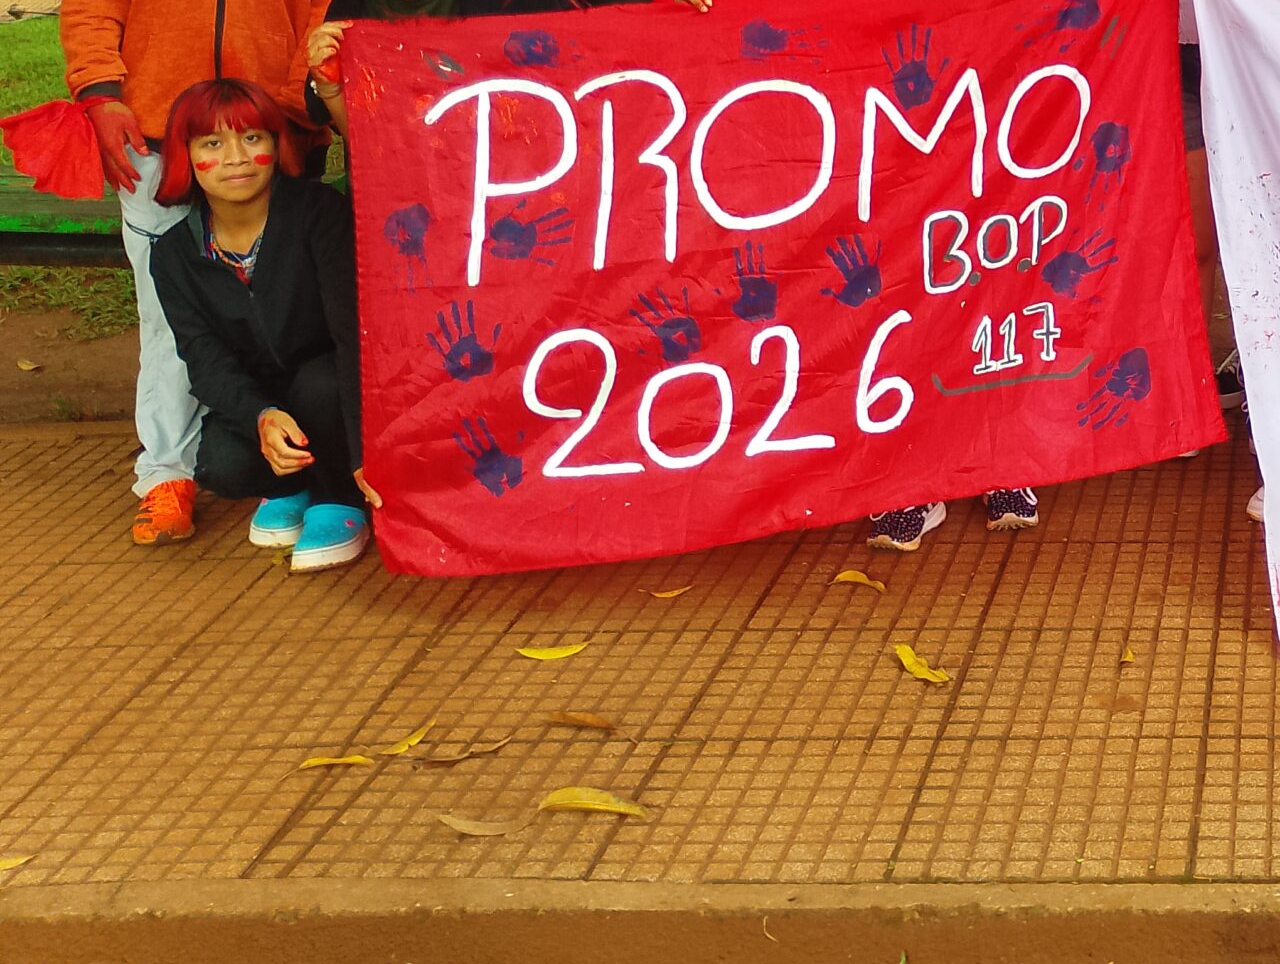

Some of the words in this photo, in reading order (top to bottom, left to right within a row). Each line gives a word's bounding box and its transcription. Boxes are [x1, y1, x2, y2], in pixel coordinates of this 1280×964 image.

[424, 64, 1092, 288] PROMO
[522, 309, 915, 478] 2026
[971, 301, 1062, 375] 117
